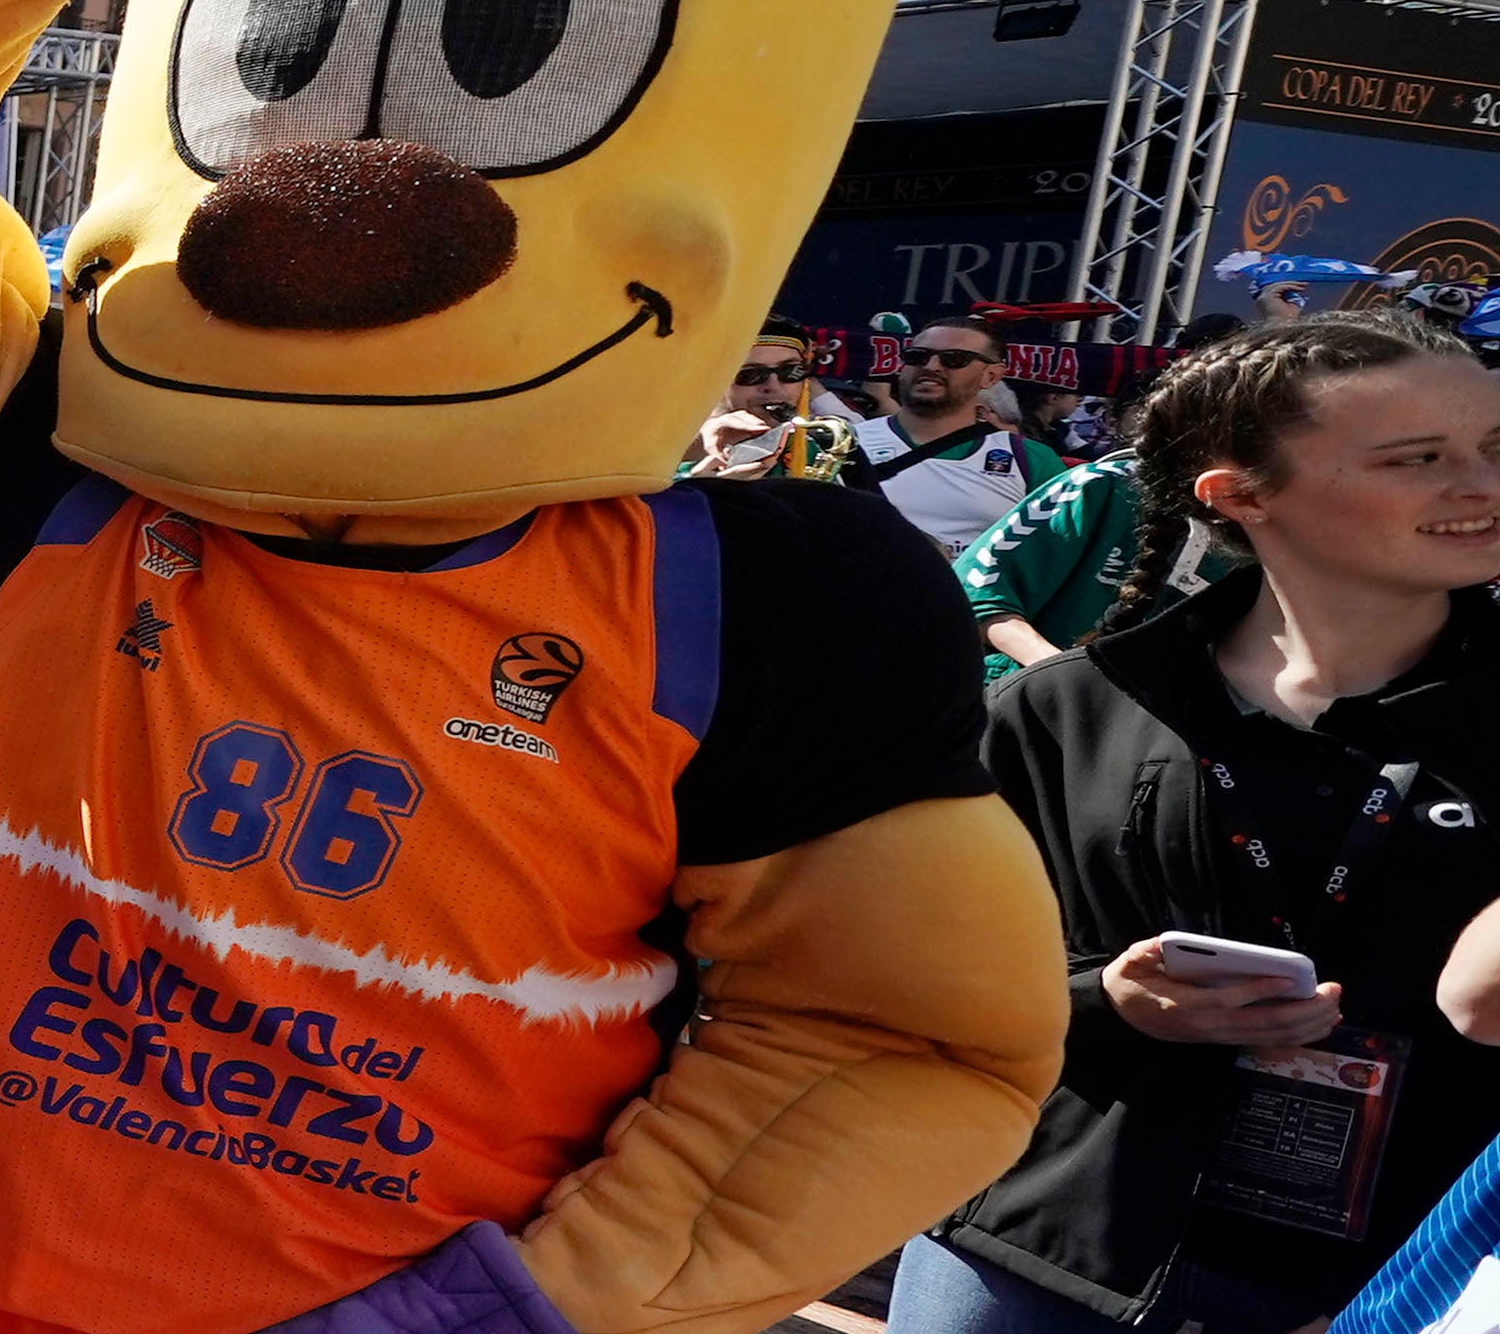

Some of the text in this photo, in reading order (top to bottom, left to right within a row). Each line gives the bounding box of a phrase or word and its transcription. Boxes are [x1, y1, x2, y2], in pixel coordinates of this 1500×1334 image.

[1282, 66, 1345, 106] COPA
[1347, 76, 1386, 111] DEL
[1387, 80, 1436, 119] REY
[494, 679, 553, 703] TURKISH
[495, 690, 548, 713] AIRLINES
[168, 720, 425, 902] 86
[48, 918, 426, 1083] Cultura del
